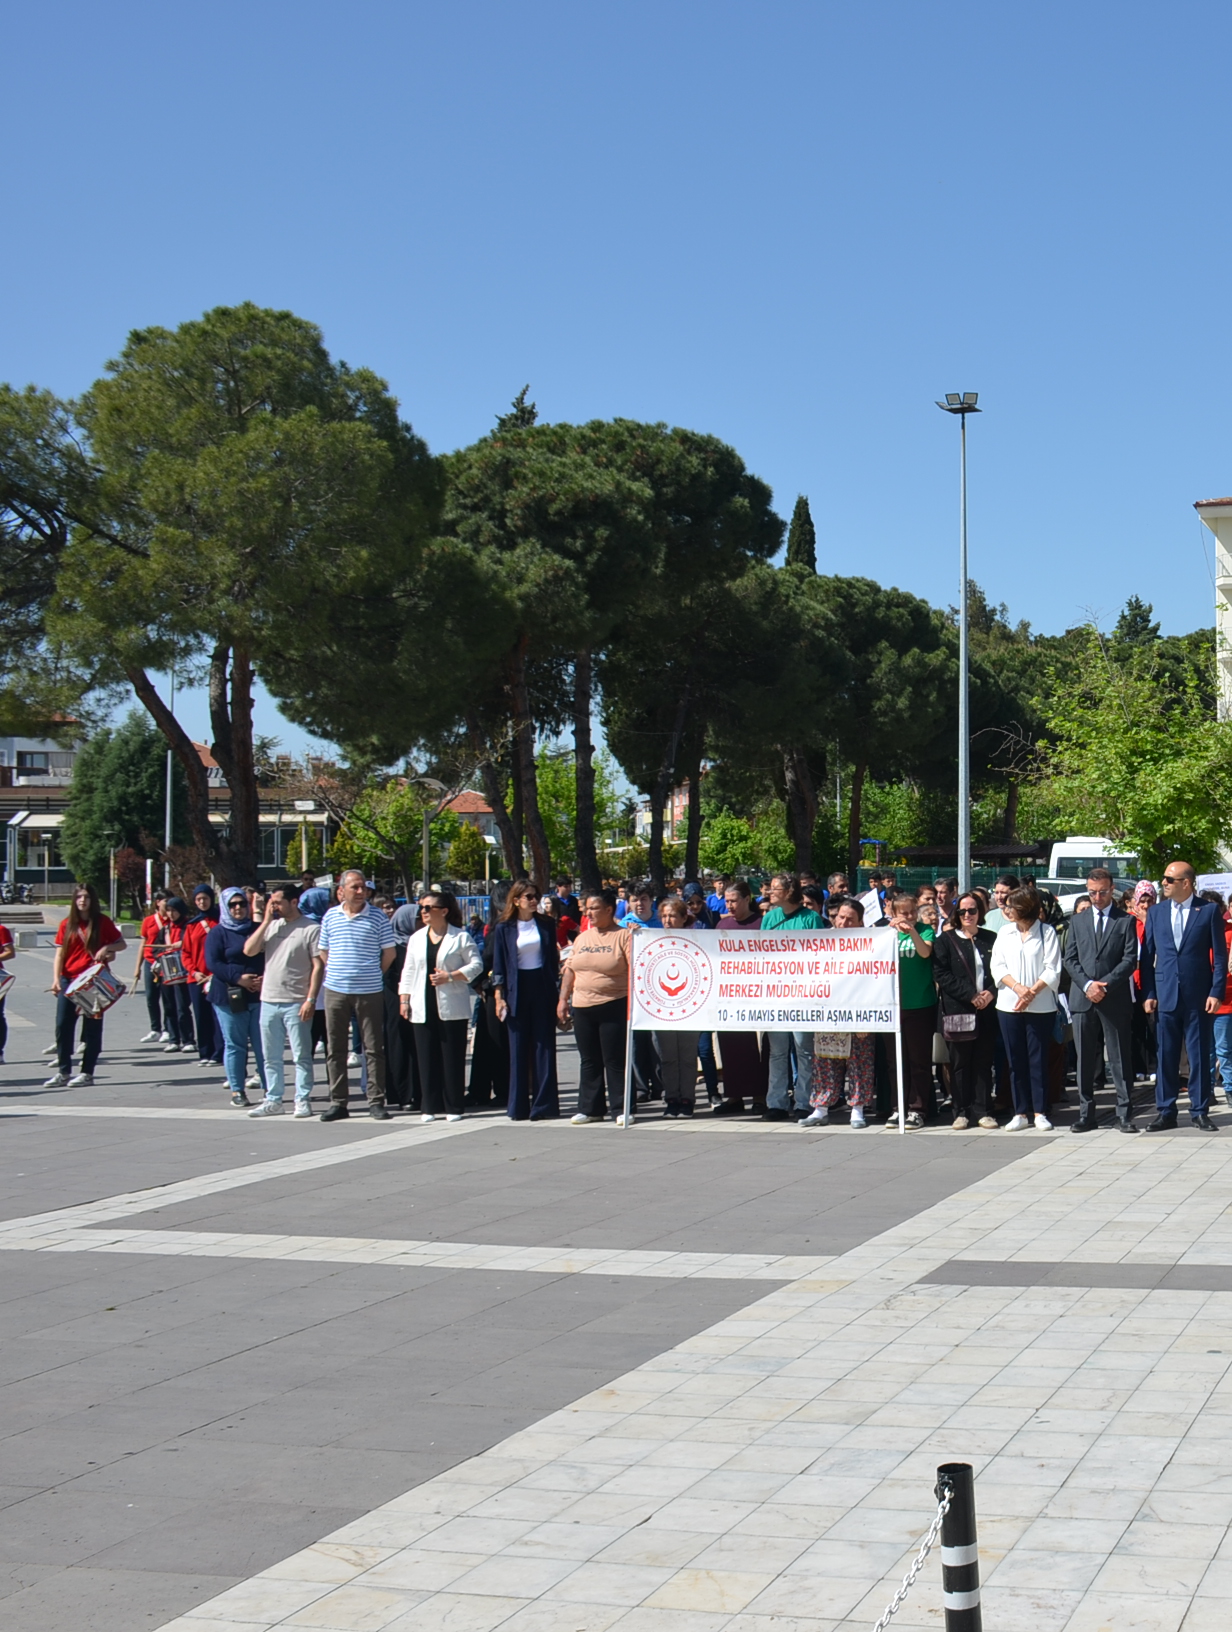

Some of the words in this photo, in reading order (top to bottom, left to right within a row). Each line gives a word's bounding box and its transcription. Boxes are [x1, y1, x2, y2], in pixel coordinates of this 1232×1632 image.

[718, 939, 746, 952] KULA
[747, 935, 797, 952] ENGELSİZ
[798, 938, 836, 956] YAŞAM
[839, 938, 874, 953] BAKIM,
[720, 957, 804, 975] REHABİLİTASYON
[807, 961, 820, 975] VE
[823, 957, 844, 974] AİLE
[847, 960, 896, 979] DANIŞMA
[719, 980, 763, 997] MERKEZİ
[766, 980, 830, 998] MÜDÜRLÜĞÜ
[718, 1009, 728, 1021] 10
[736, 1009, 746, 1021] 16
[748, 1009, 775, 1021] MAYIS
[778, 1006, 824, 1022] ENGELLERİ
[827, 1010, 853, 1026] AŞMA
[856, 1010, 892, 1022] HAFTASI
